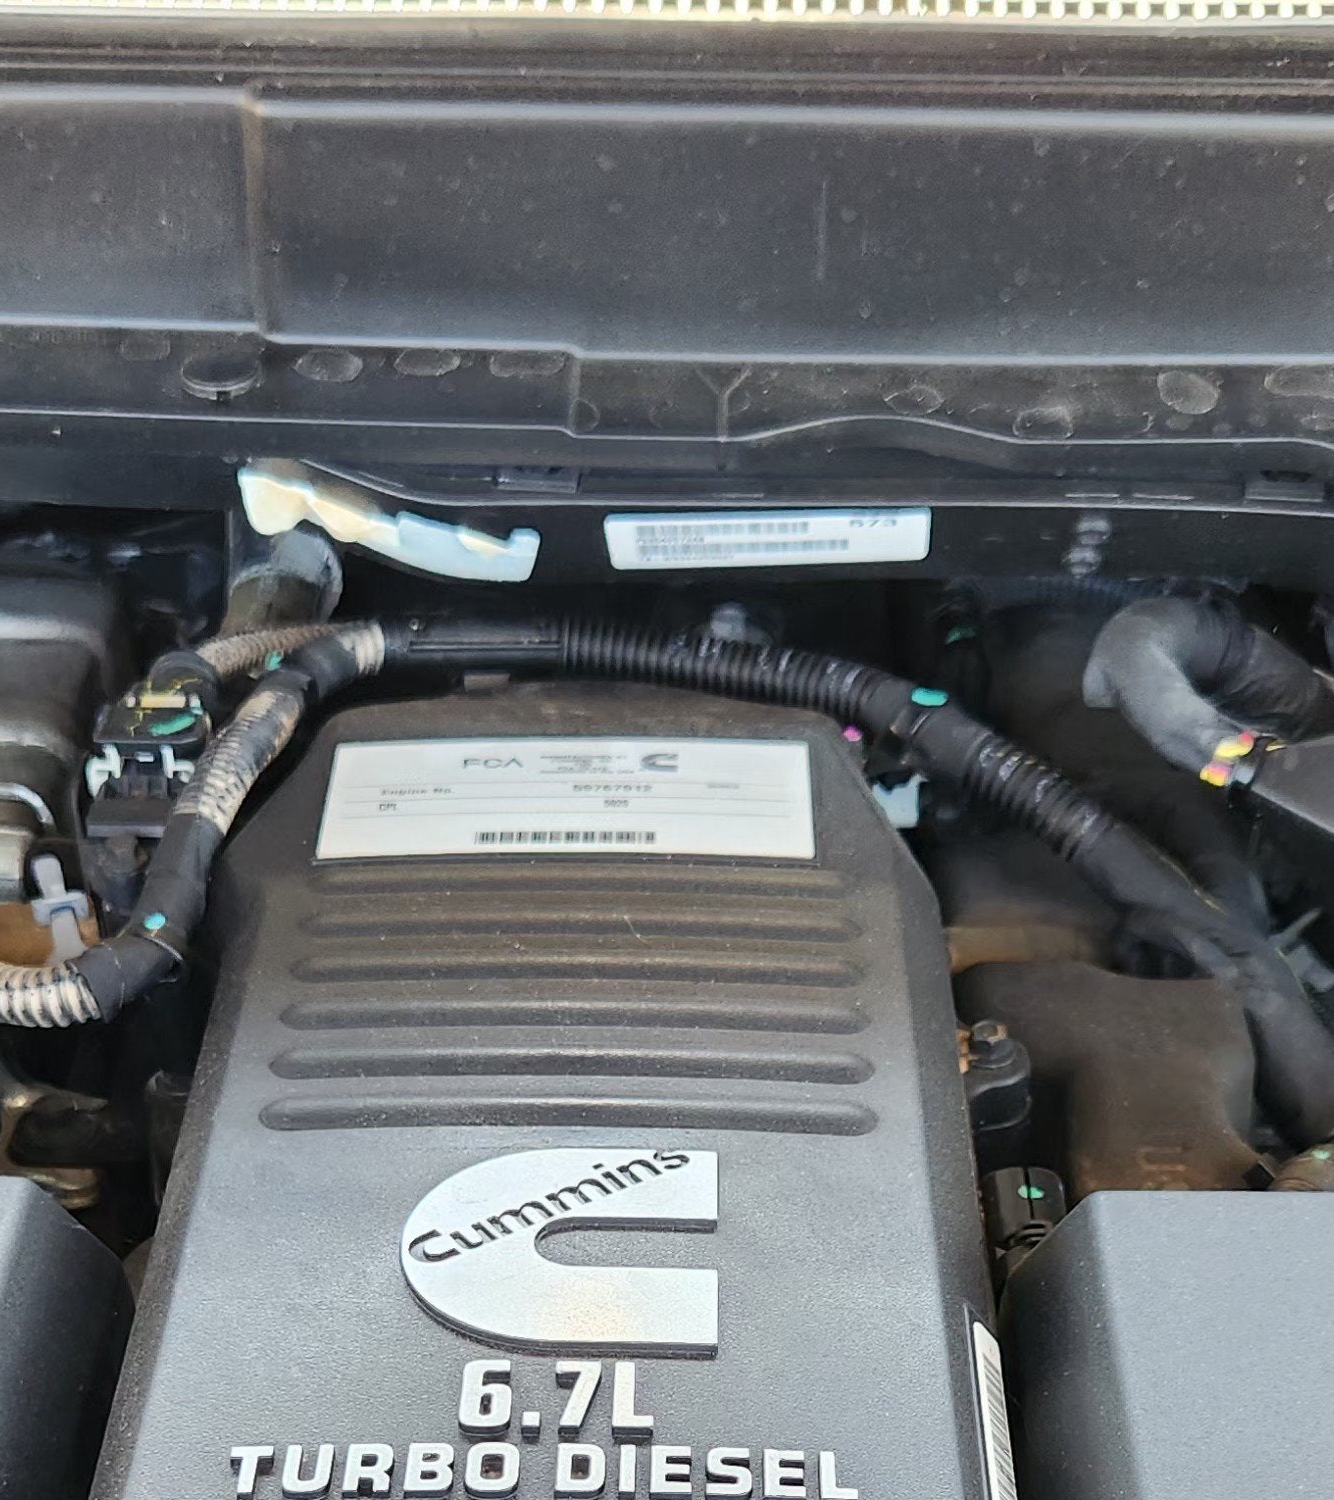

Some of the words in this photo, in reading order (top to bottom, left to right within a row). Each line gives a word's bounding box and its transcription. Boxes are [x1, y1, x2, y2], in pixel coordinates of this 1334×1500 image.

[462, 757, 524, 770] FCA
[380, 788, 427, 797] Engine
[408, 1148, 691, 1264] Cummins
[458, 1360, 655, 1438] 6.7L
